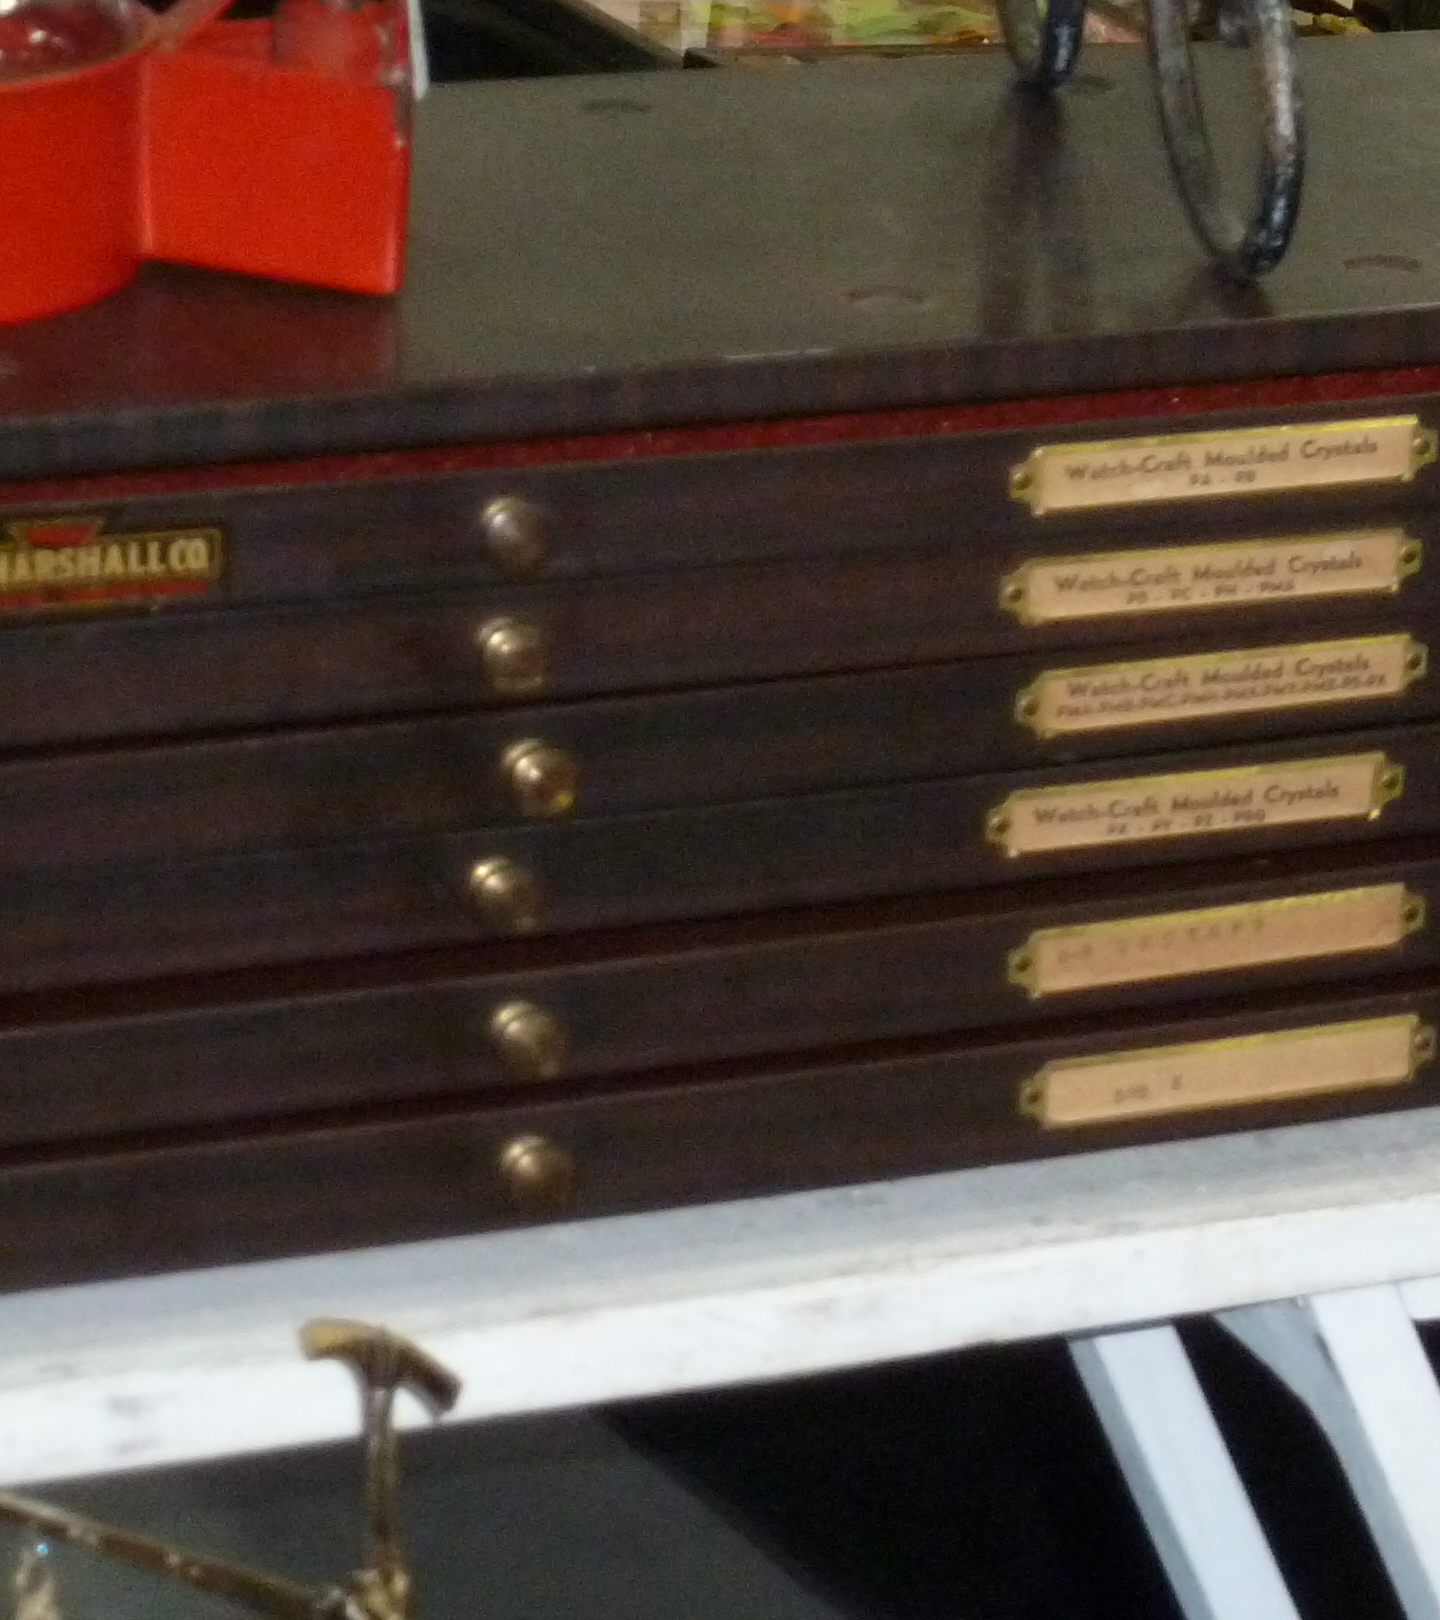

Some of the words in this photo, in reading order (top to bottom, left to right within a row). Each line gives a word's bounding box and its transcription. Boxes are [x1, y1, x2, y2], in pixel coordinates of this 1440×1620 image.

[1302, 436, 1378, 461] Crystals
[1287, 550, 1363, 574] Crystals
[1294, 654, 1370, 677] Crystals
[1263, 781, 1340, 806] Crystals
